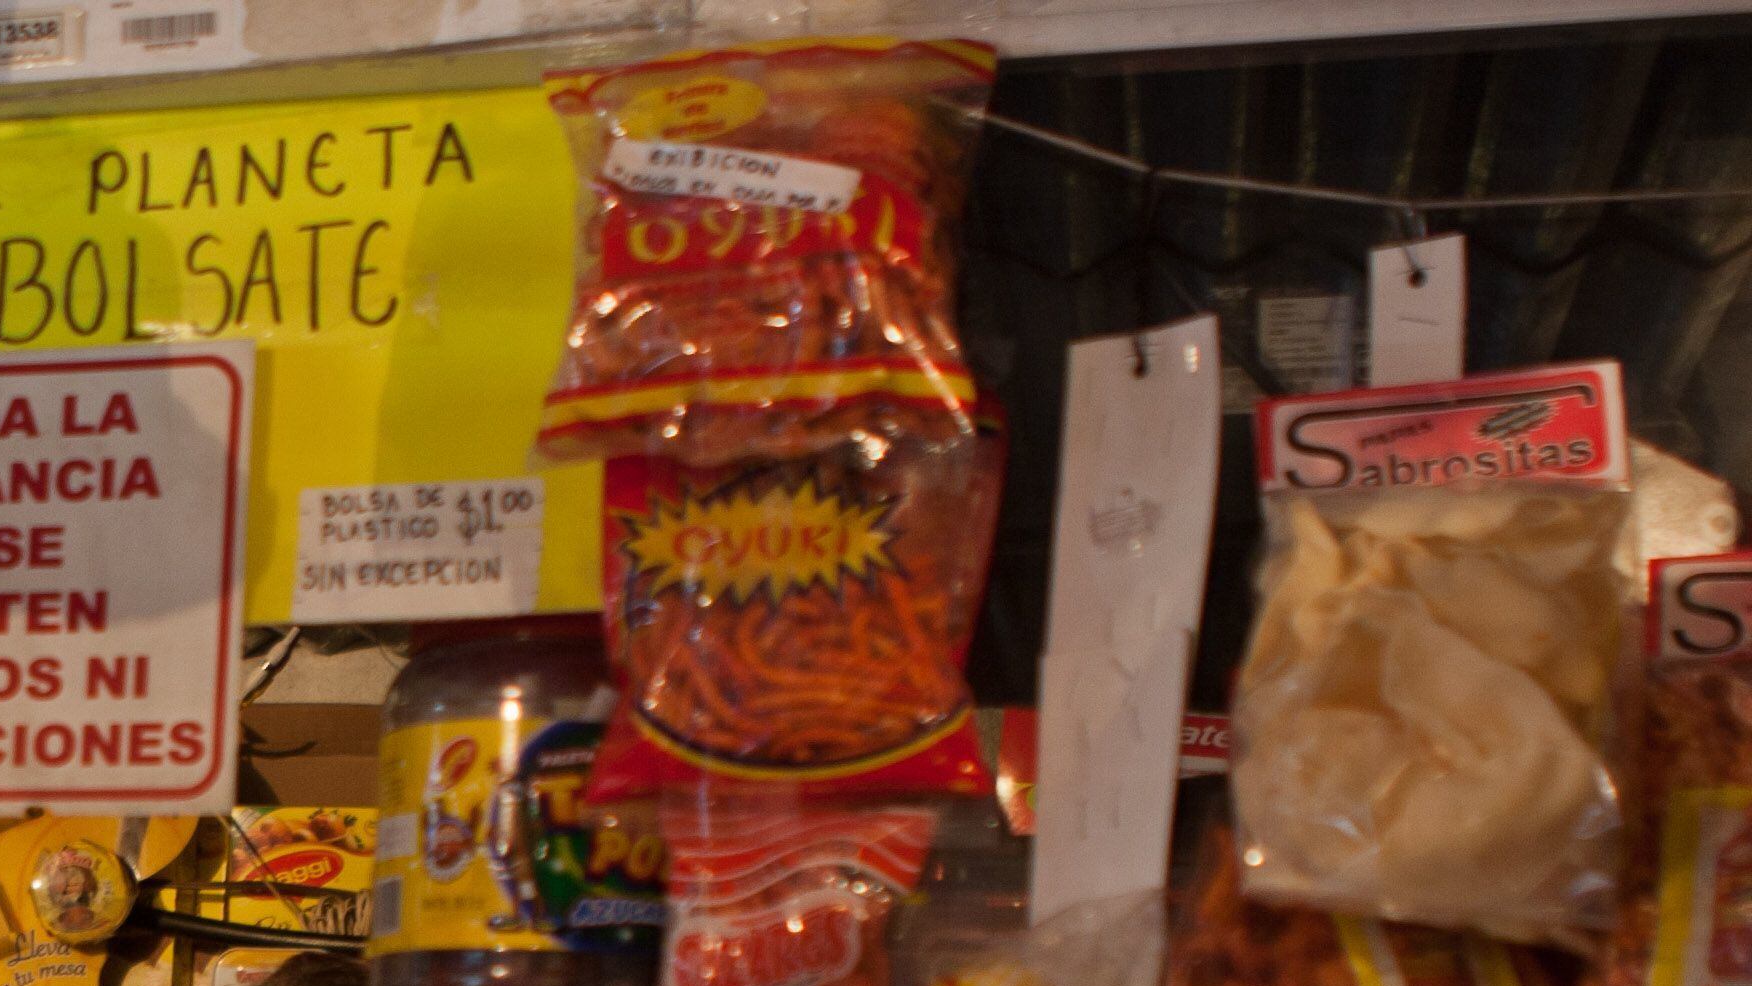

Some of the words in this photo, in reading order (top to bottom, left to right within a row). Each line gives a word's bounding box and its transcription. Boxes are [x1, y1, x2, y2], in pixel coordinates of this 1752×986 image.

[87, 122, 476, 215] PLANETA
[60, 393, 138, 437] LA
[1284, 384, 1596, 490] Sabrositas
[320, 487, 399, 518] BOLSA
[302, 561, 347, 592] SIN
[355, 557, 502, 587] EXCEPCION
[86, 656, 148, 701] NI
[7, 928, 72, 967] Lleva
[39, 963, 87, 979] mesa
